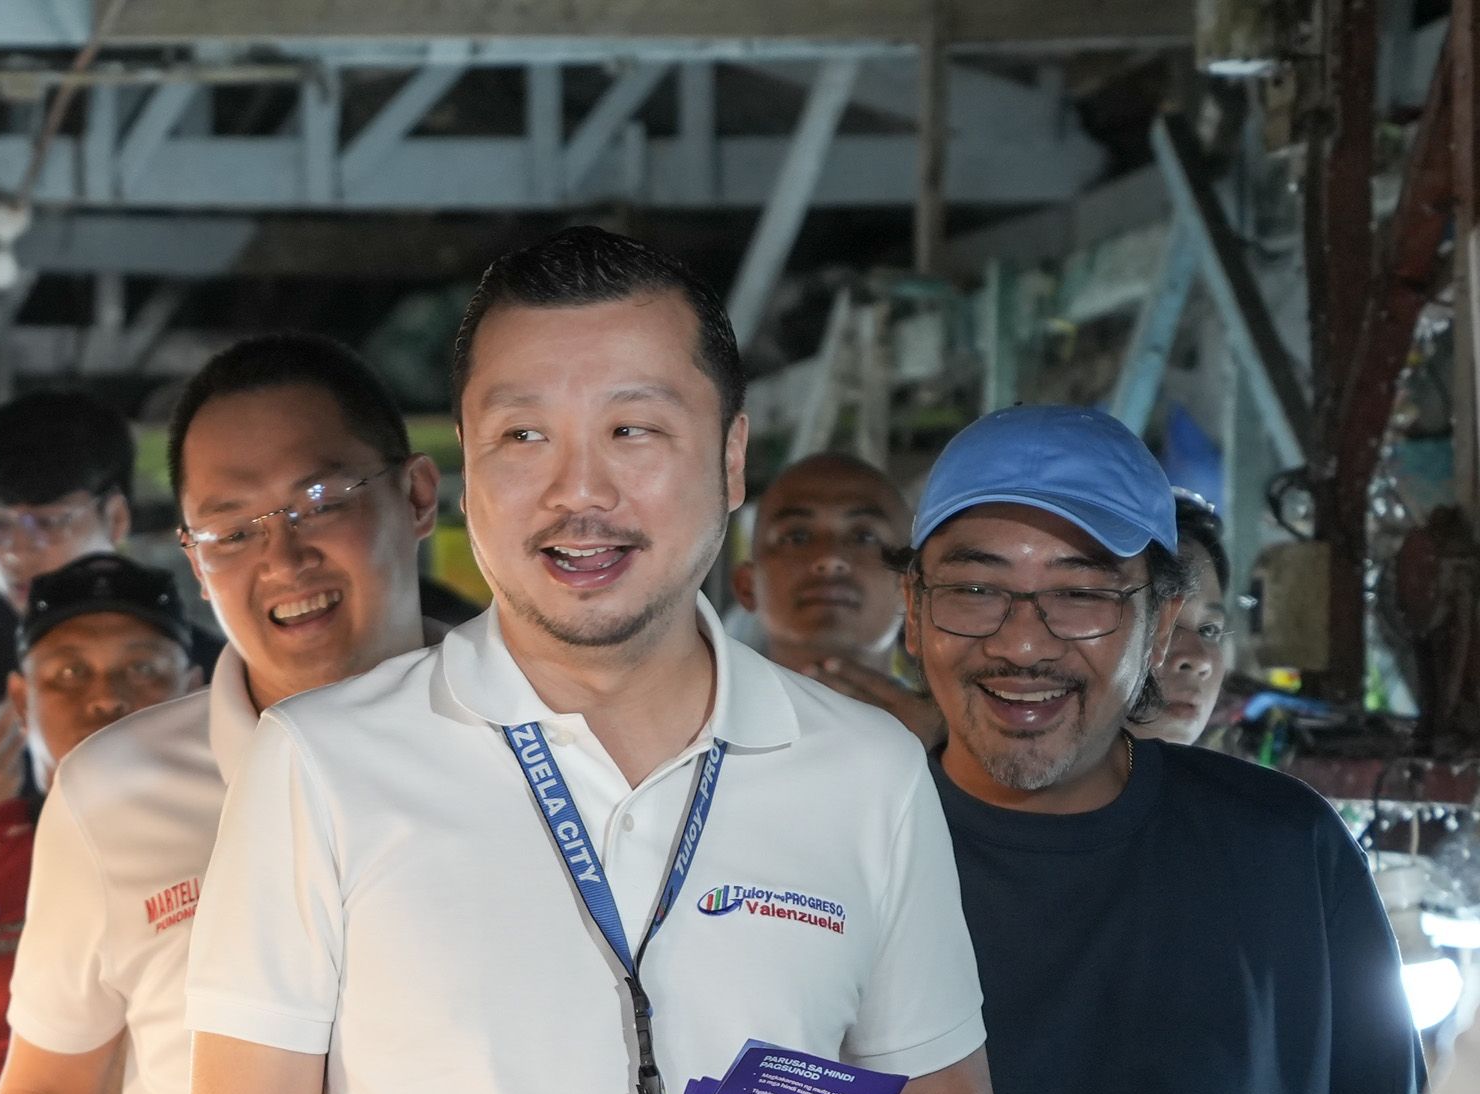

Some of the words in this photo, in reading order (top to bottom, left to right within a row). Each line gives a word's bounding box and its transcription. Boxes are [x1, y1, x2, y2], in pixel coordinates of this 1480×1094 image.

[511, 724, 568, 817] ZUELA
[556, 820, 601, 884] CITY
[674, 807, 703, 876] Tuloy
[700, 740, 723, 799] PRO
[733, 885, 773, 902] Tuloy
[785, 891, 846, 920] PROGRESO,
[746, 899, 845, 935] Valenzuela!
[759, 1061, 821, 1081] PAGSUNOD
[763, 1055, 807, 1070] PARUSA
[807, 1064, 823, 1074] SA
[823, 1069, 856, 1082] HINDI
